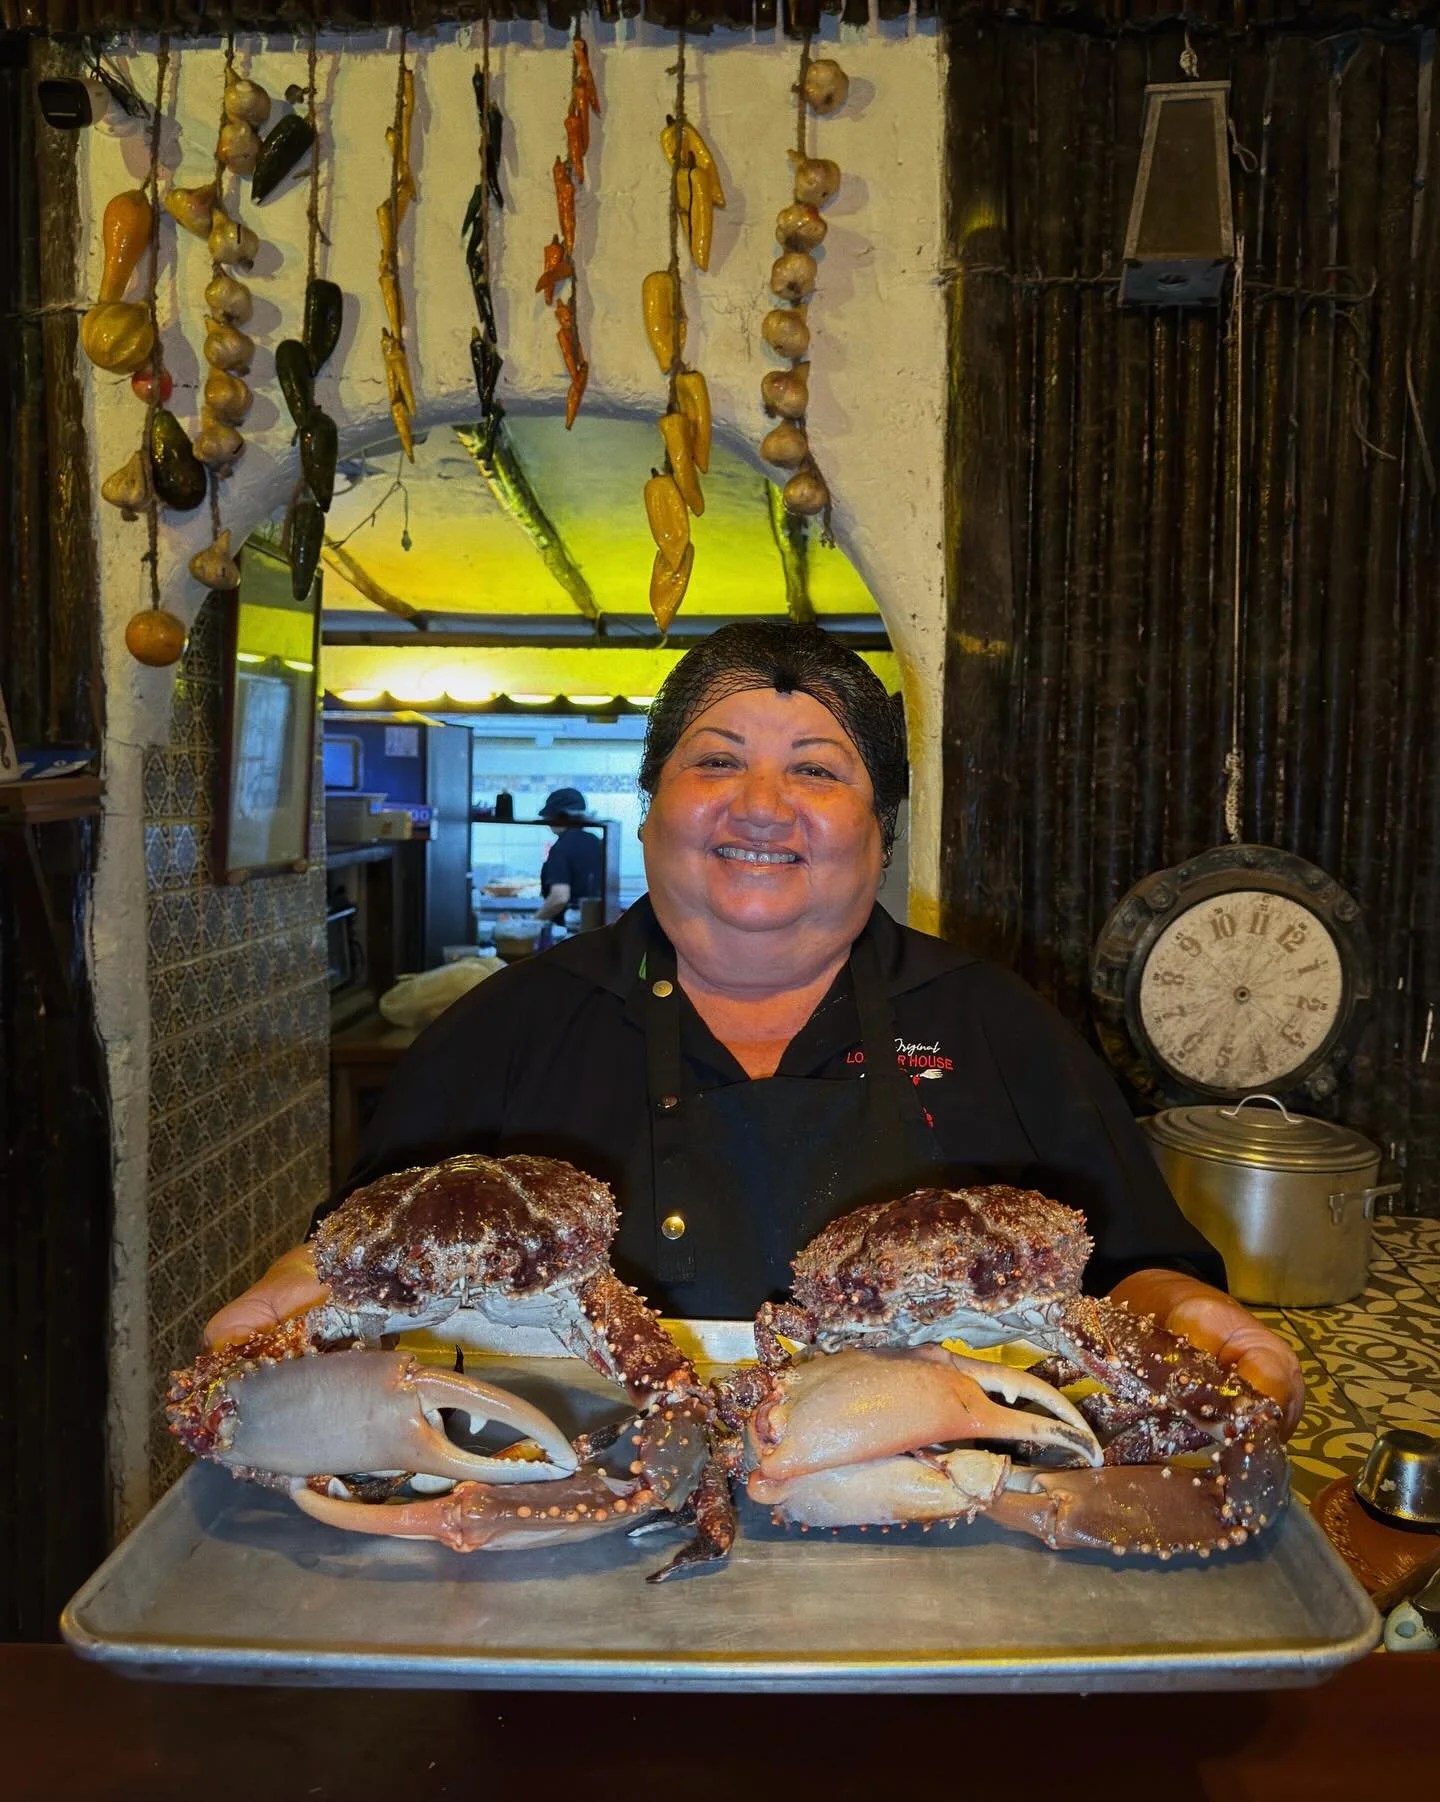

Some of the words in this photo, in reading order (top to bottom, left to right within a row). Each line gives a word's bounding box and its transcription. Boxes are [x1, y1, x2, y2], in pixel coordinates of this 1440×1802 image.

[1209, 913, 1237, 941] 10
[1249, 911, 1270, 936] 11
[1179, 935, 1203, 958] 9
[1276, 923, 1306, 953] 12
[1297, 957, 1321, 976] 1
[1160, 971, 1185, 986] 8
[1296, 995, 1321, 1012] 2
[909, 1054, 953, 1070] HOUSE
